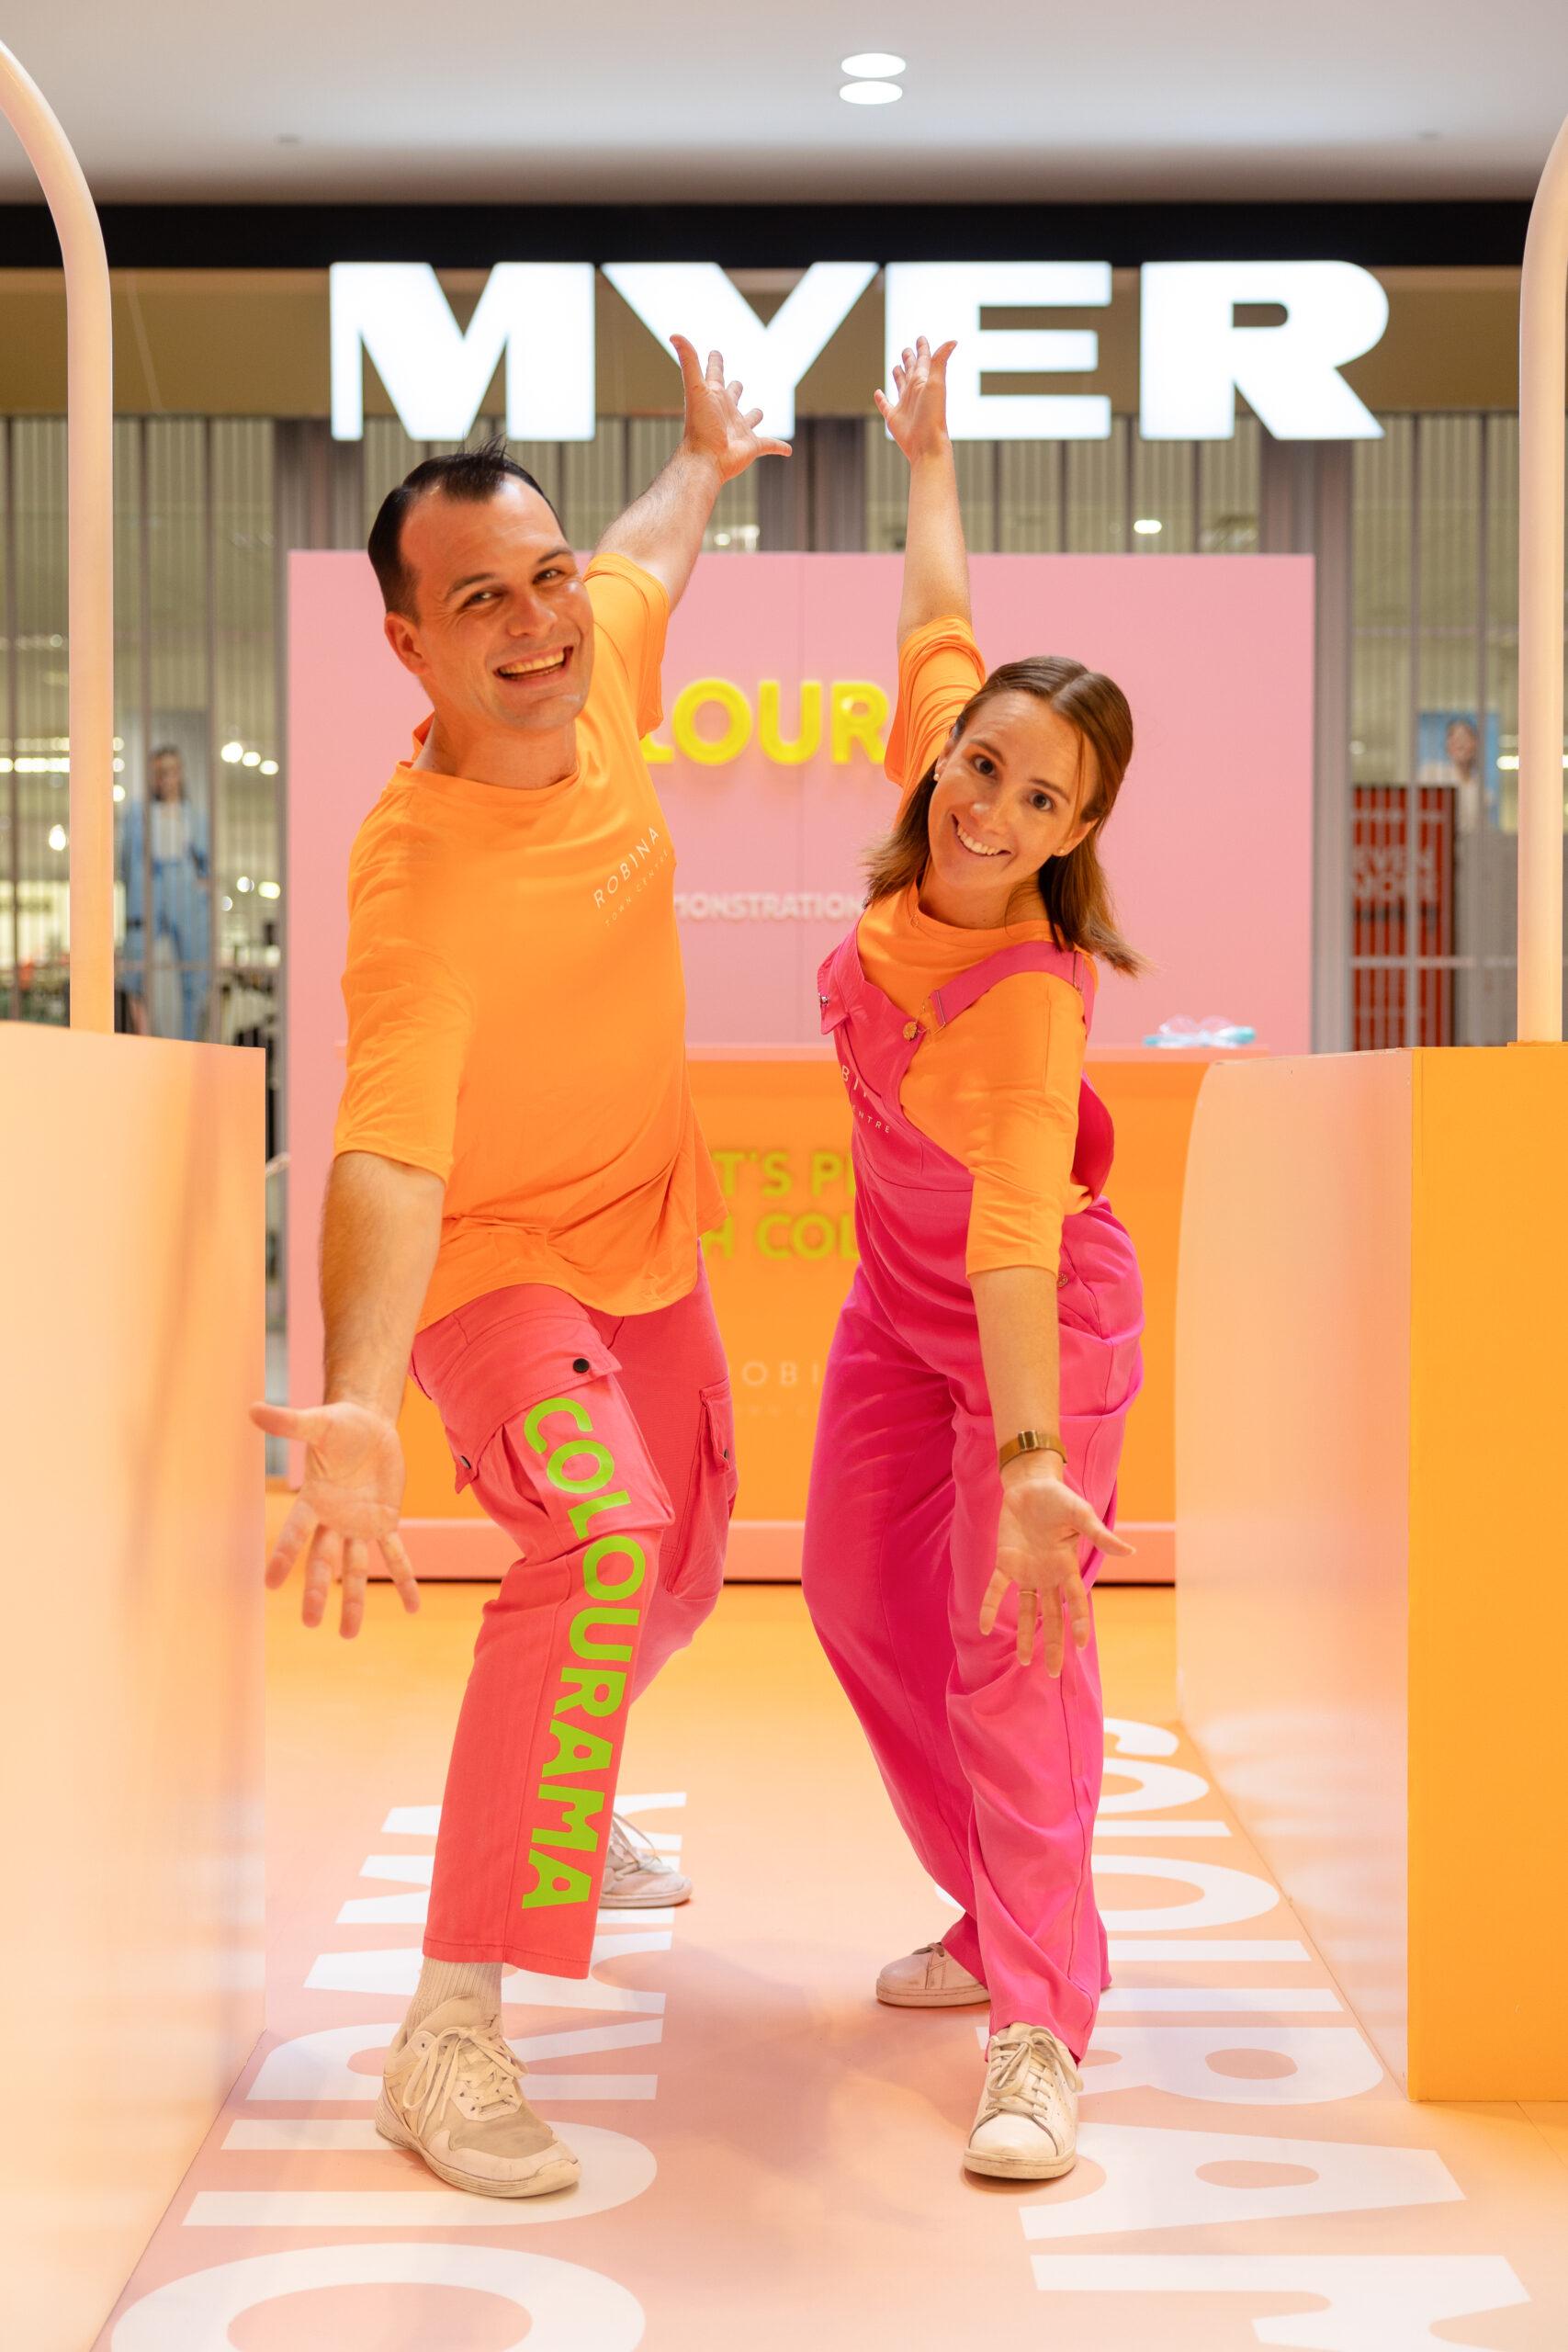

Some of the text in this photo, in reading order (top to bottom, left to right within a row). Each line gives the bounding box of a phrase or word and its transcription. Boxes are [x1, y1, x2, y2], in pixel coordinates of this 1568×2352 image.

[329, 260, 1389, 442] MYER
[593, 827, 659, 910] ROBINA
[711, 1150, 793, 1196] T'S
[756, 1212, 861, 1261] COL
[523, 1396, 646, 1910] COLOURAMA
[935, 1717, 1532, 2352] OURAM
